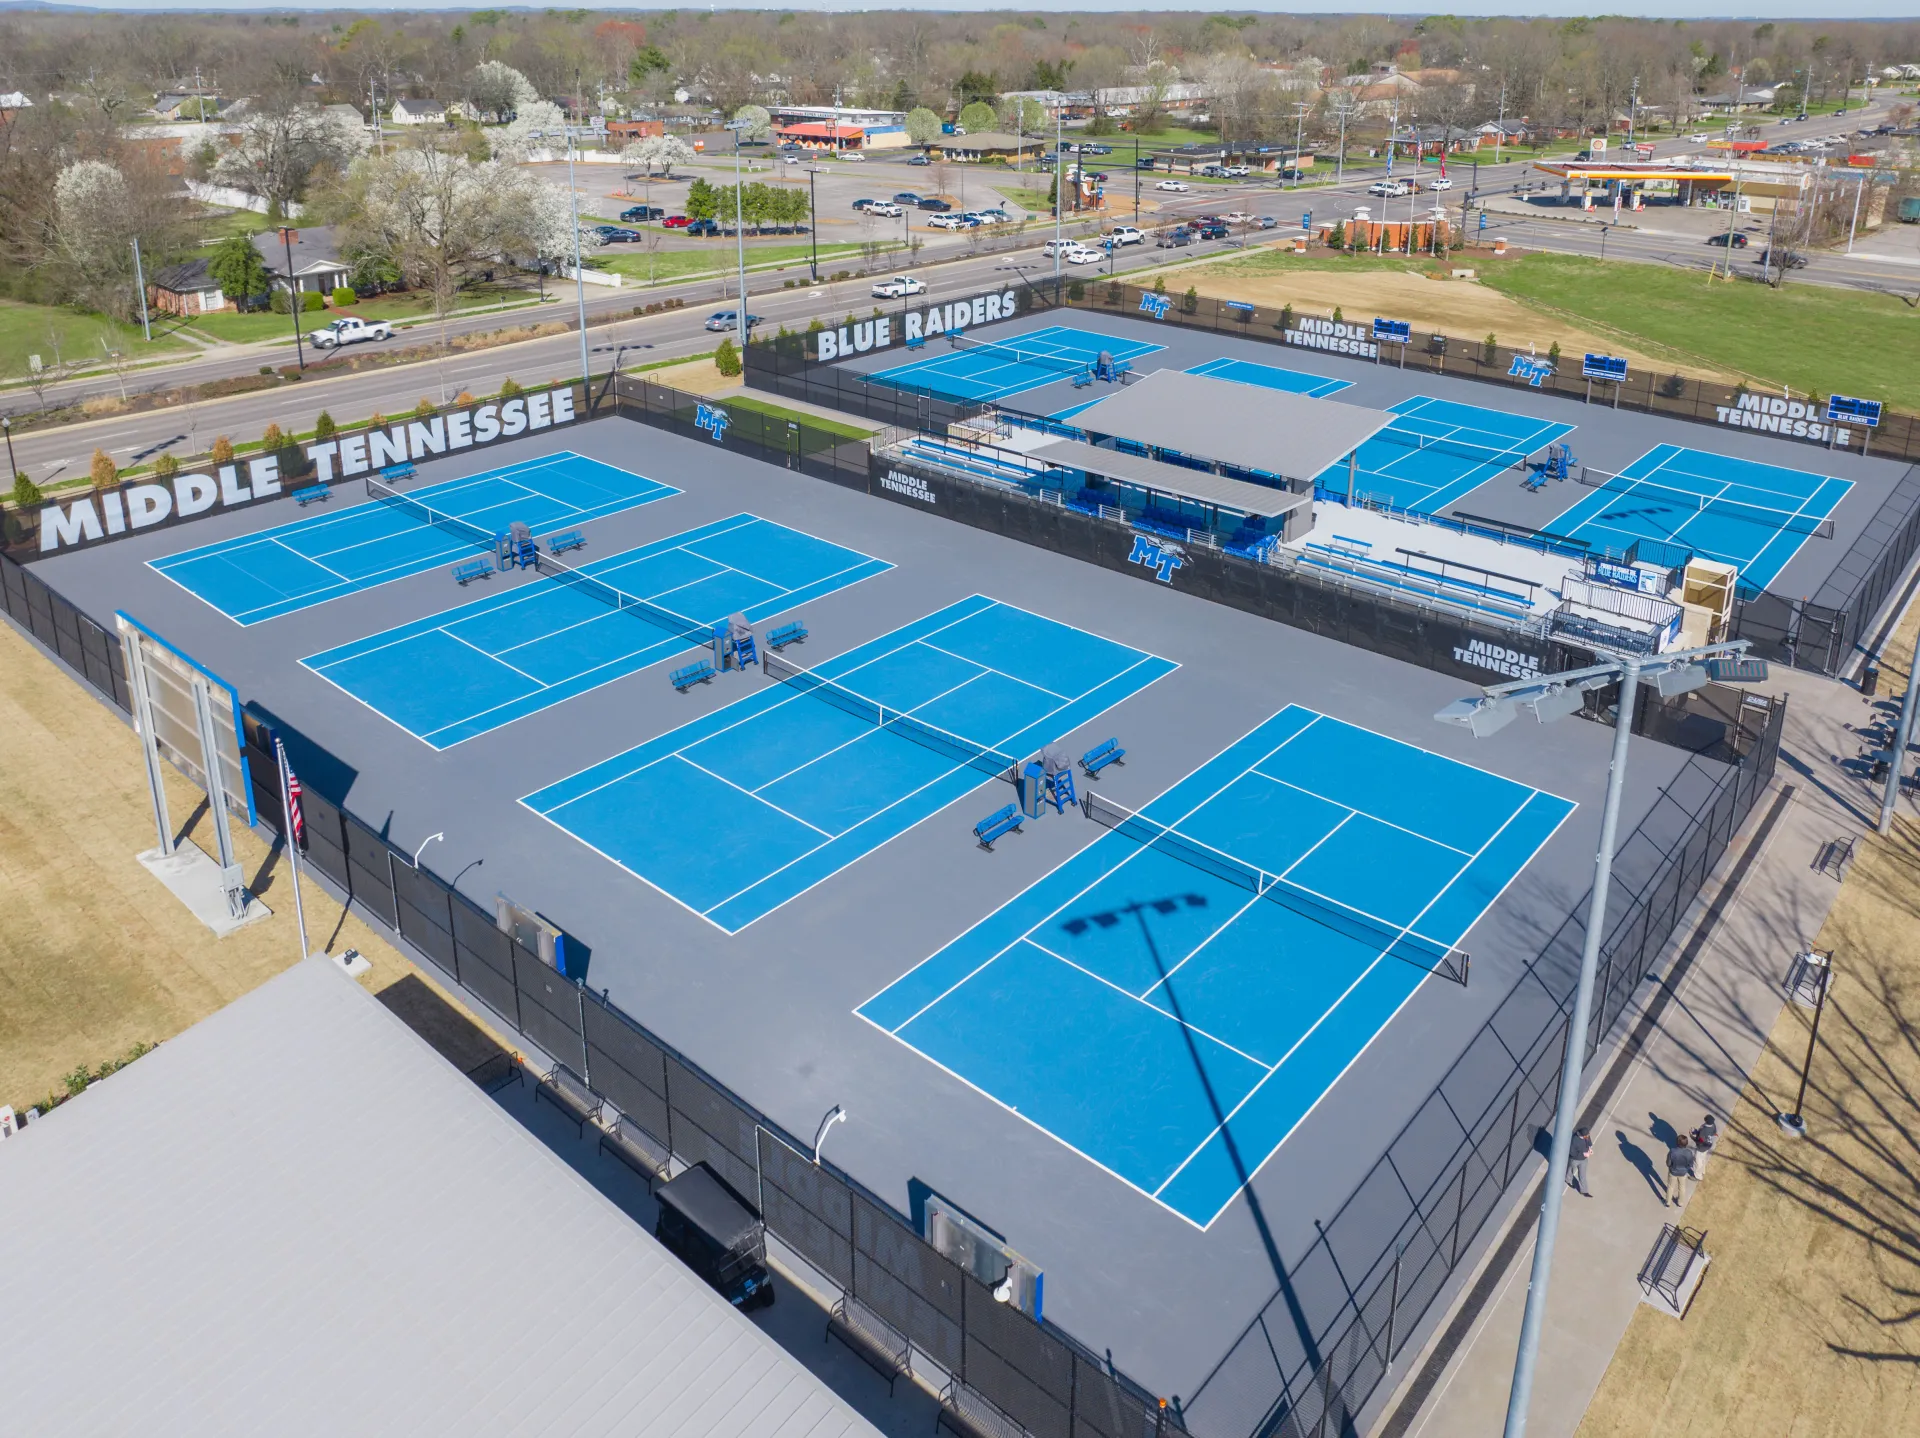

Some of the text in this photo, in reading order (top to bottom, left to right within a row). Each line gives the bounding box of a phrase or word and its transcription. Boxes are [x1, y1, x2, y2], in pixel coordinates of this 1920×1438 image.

[1139, 293, 1170, 319] MT
[818, 291, 1015, 361] BLUE RAIDERS
[1299, 318, 1366, 341] MIDDLE
[1285, 329, 1377, 358] TENNESSEE
[1507, 356, 1550, 387] MT
[695, 404, 727, 440] MT
[40, 388, 575, 552] MIDDLE TENNESSEE
[888, 470, 927, 491] MIDDLE
[880, 477, 936, 504] TENNESSEE
[1128, 535, 1183, 583] MT
[1597, 565, 1611, 578] BLUE
[1612, 570, 1637, 584] RAIDERS
[1453, 646, 1548, 681] TENNESSE
[1469, 639, 1539, 670] MIDDLE
